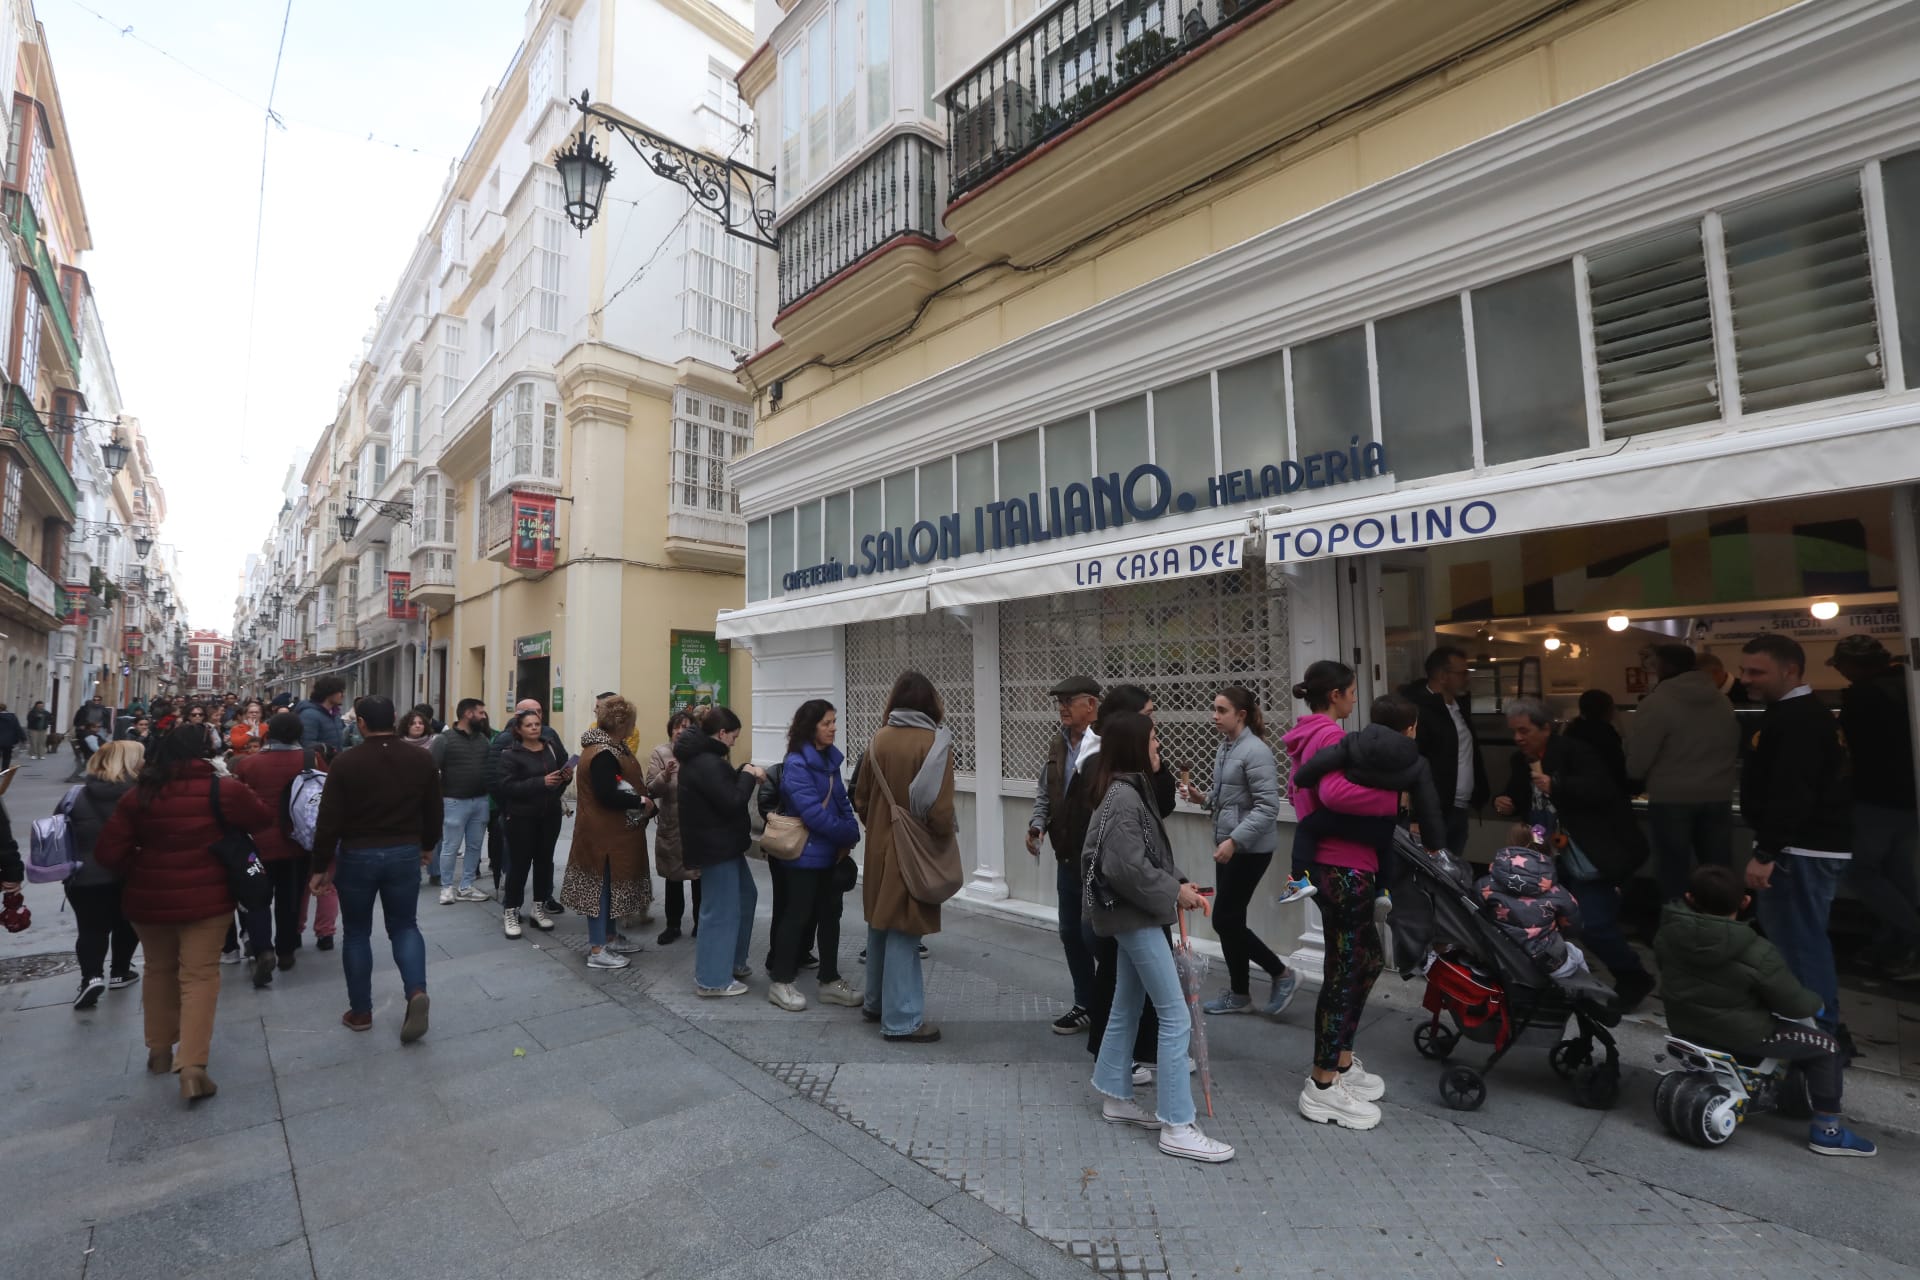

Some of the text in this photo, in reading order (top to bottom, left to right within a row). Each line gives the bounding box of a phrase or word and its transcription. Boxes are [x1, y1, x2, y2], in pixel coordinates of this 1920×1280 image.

[860, 512, 960, 575] SALON
[974, 463, 1172, 553] ITALIANO
[1207, 434, 1388, 508] HELADERÍA
[1076, 500, 1497, 586] LA CASA DEL TOPOLINO
[681, 653, 706, 666] fuze
[681, 665, 701, 675] tea
